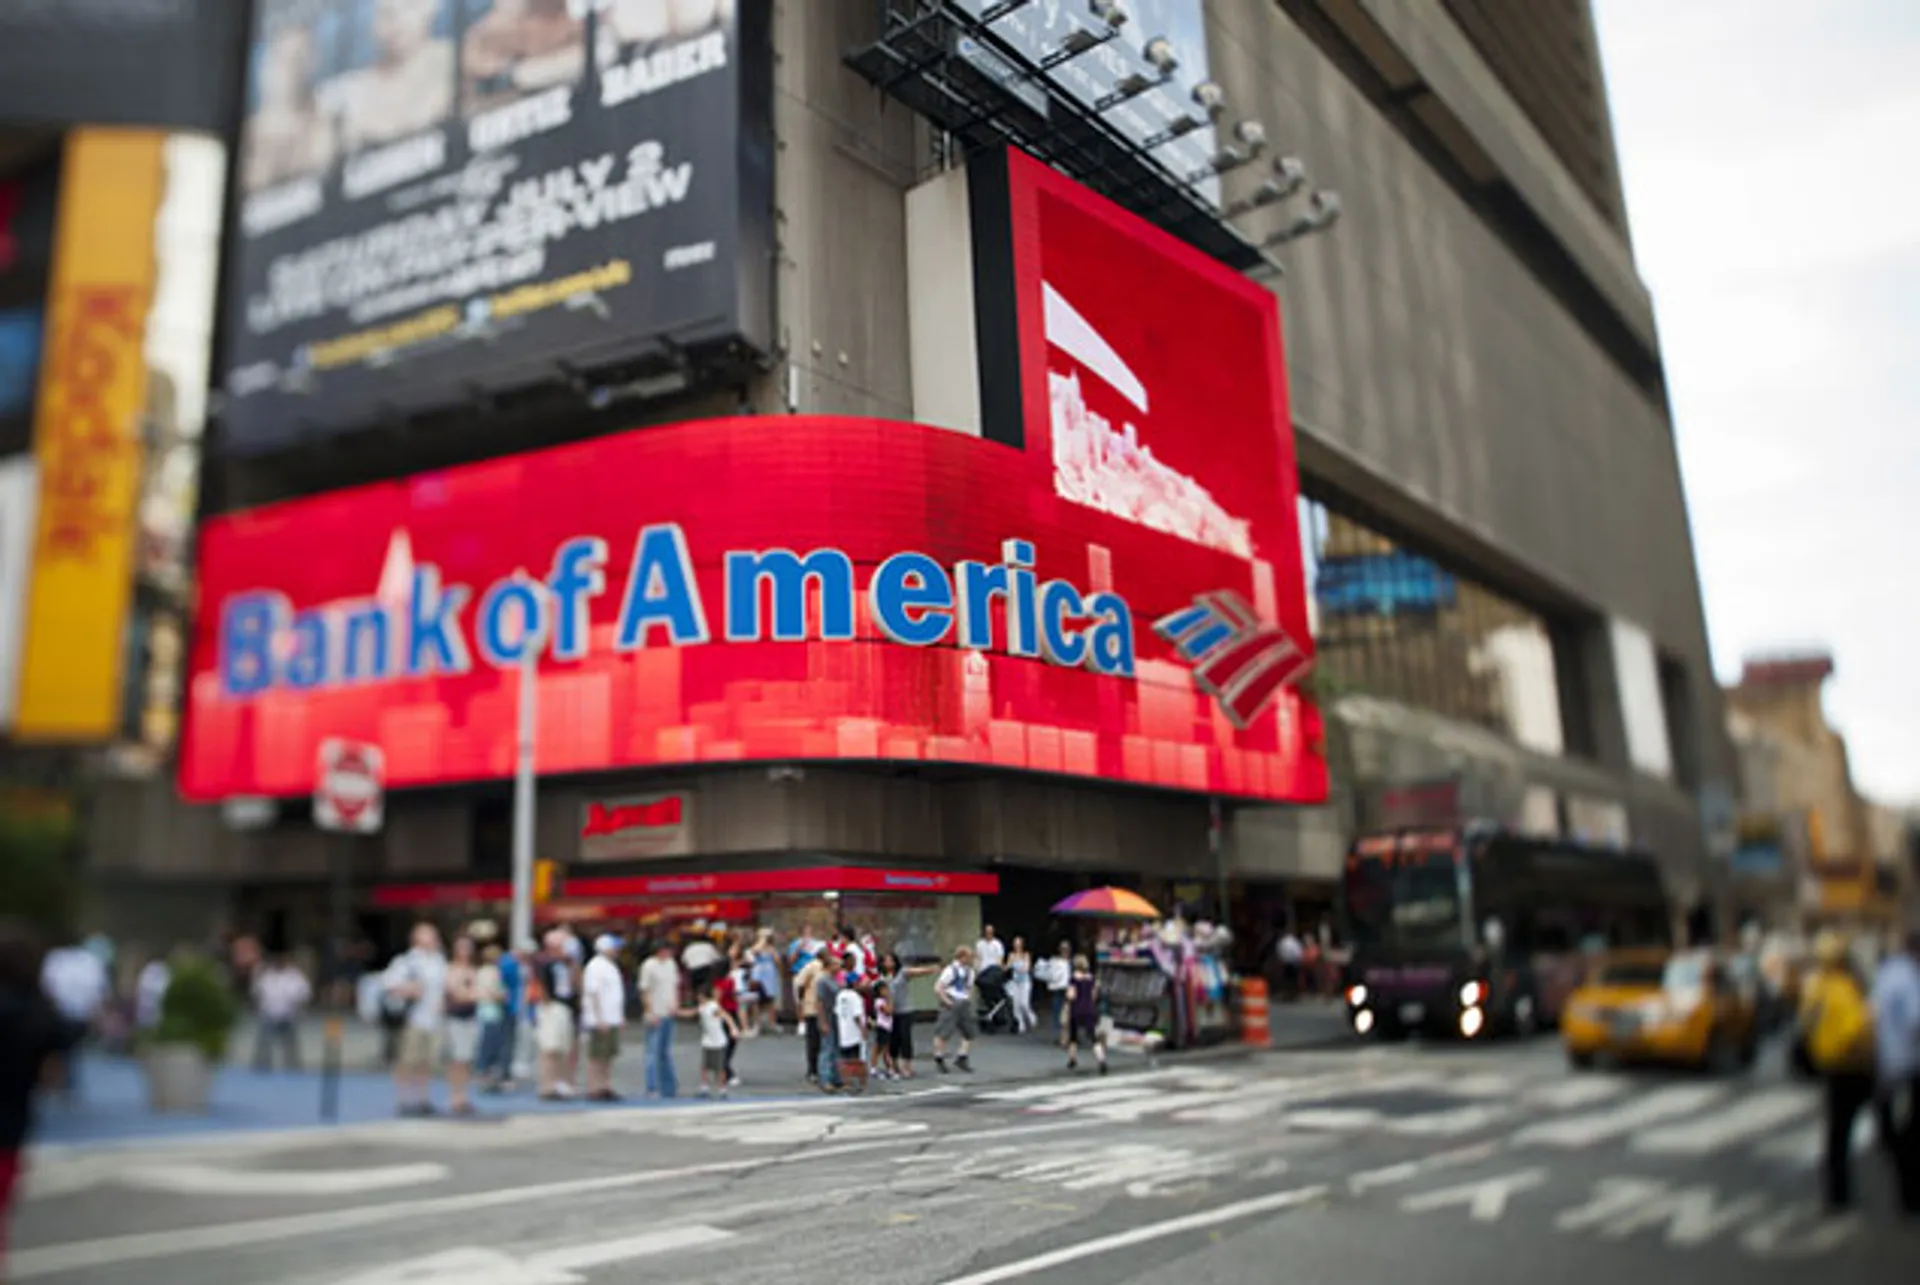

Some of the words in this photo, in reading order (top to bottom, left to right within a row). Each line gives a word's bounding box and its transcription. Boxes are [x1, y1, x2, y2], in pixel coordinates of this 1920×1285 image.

[221, 563, 472, 700] Bank
[476, 537, 608, 670] of
[614, 522, 1135, 677] America
